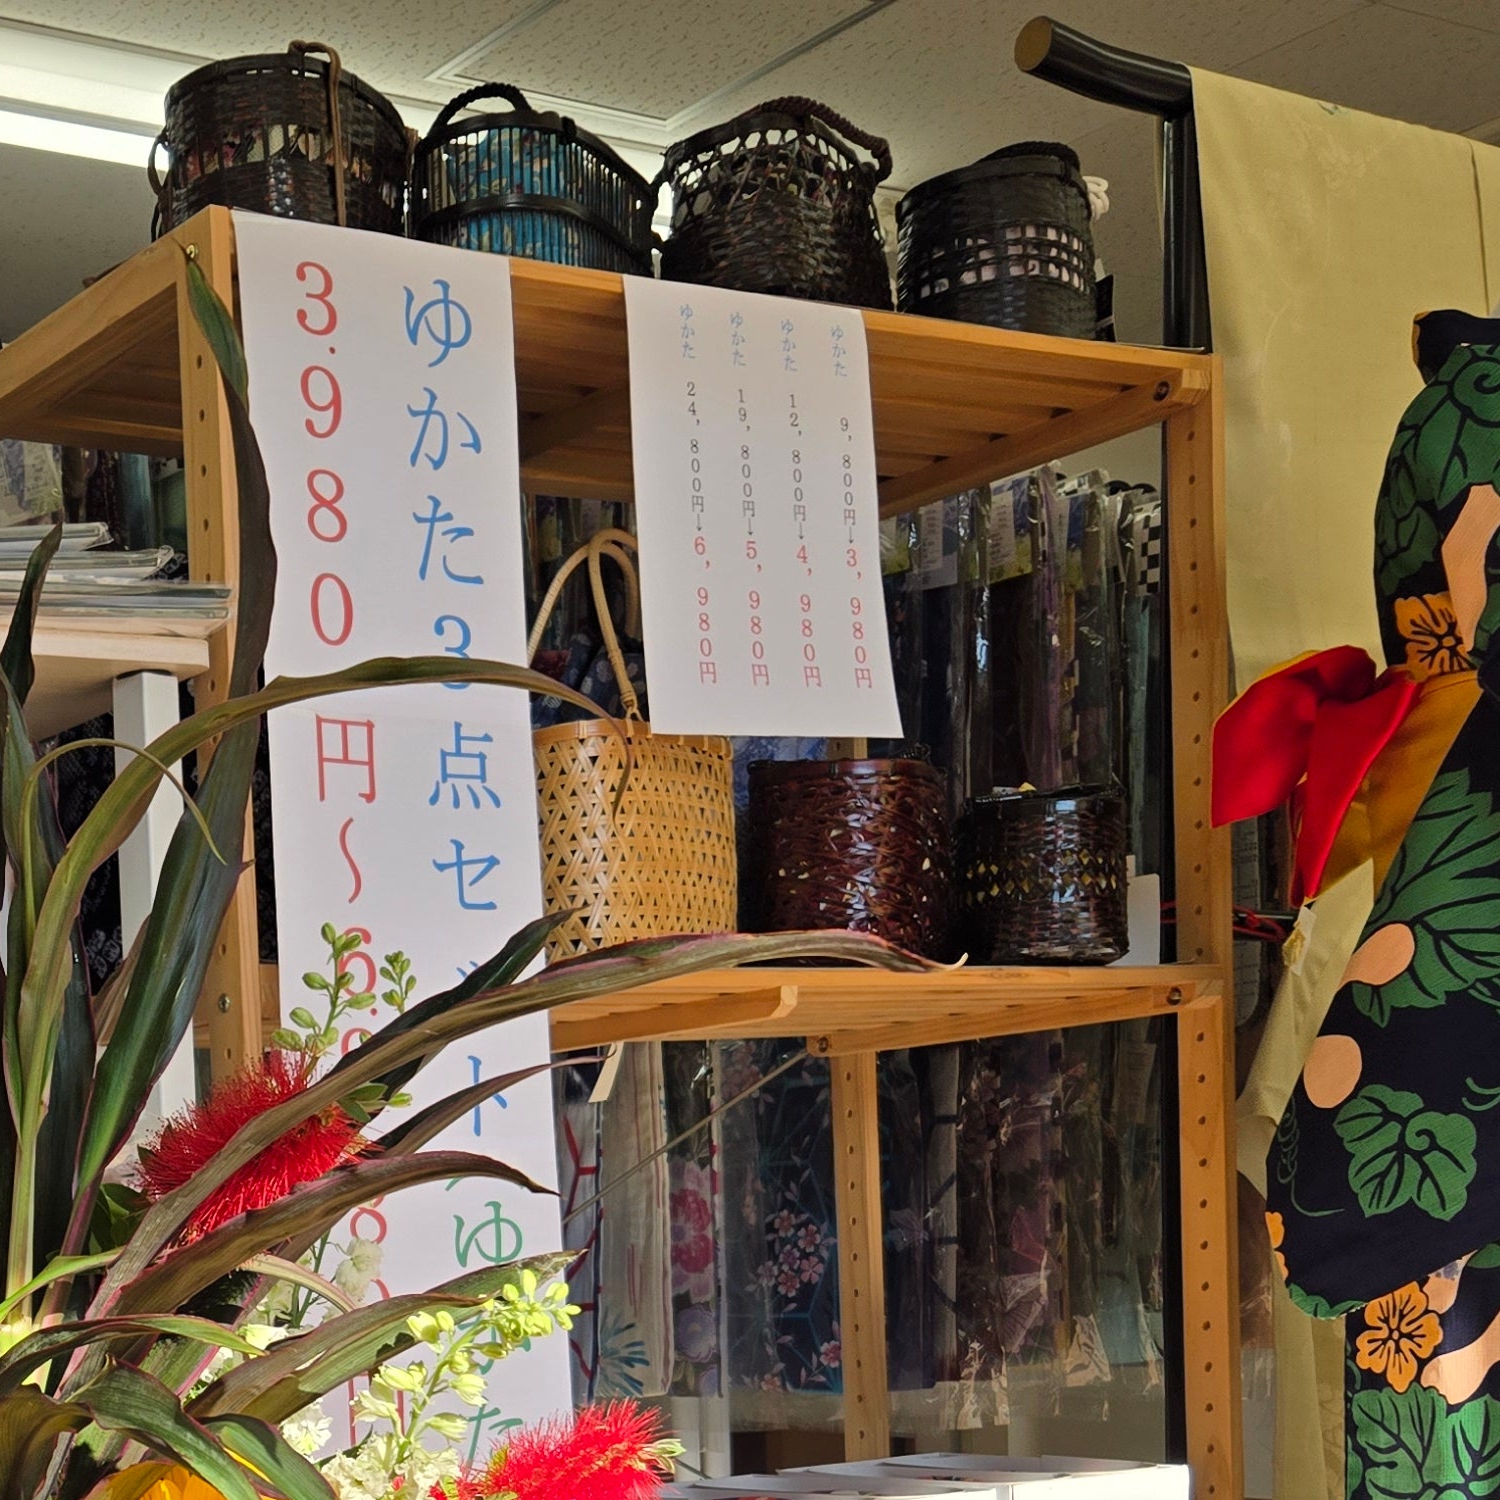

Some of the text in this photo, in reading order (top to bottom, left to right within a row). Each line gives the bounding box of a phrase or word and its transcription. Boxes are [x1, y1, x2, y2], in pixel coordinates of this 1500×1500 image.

[679, 303, 697, 360] ゆかた
[729, 311, 747, 367] ゆかた
[780, 317, 798, 372] ゆかた
[830, 324, 848, 379] ゆかた
